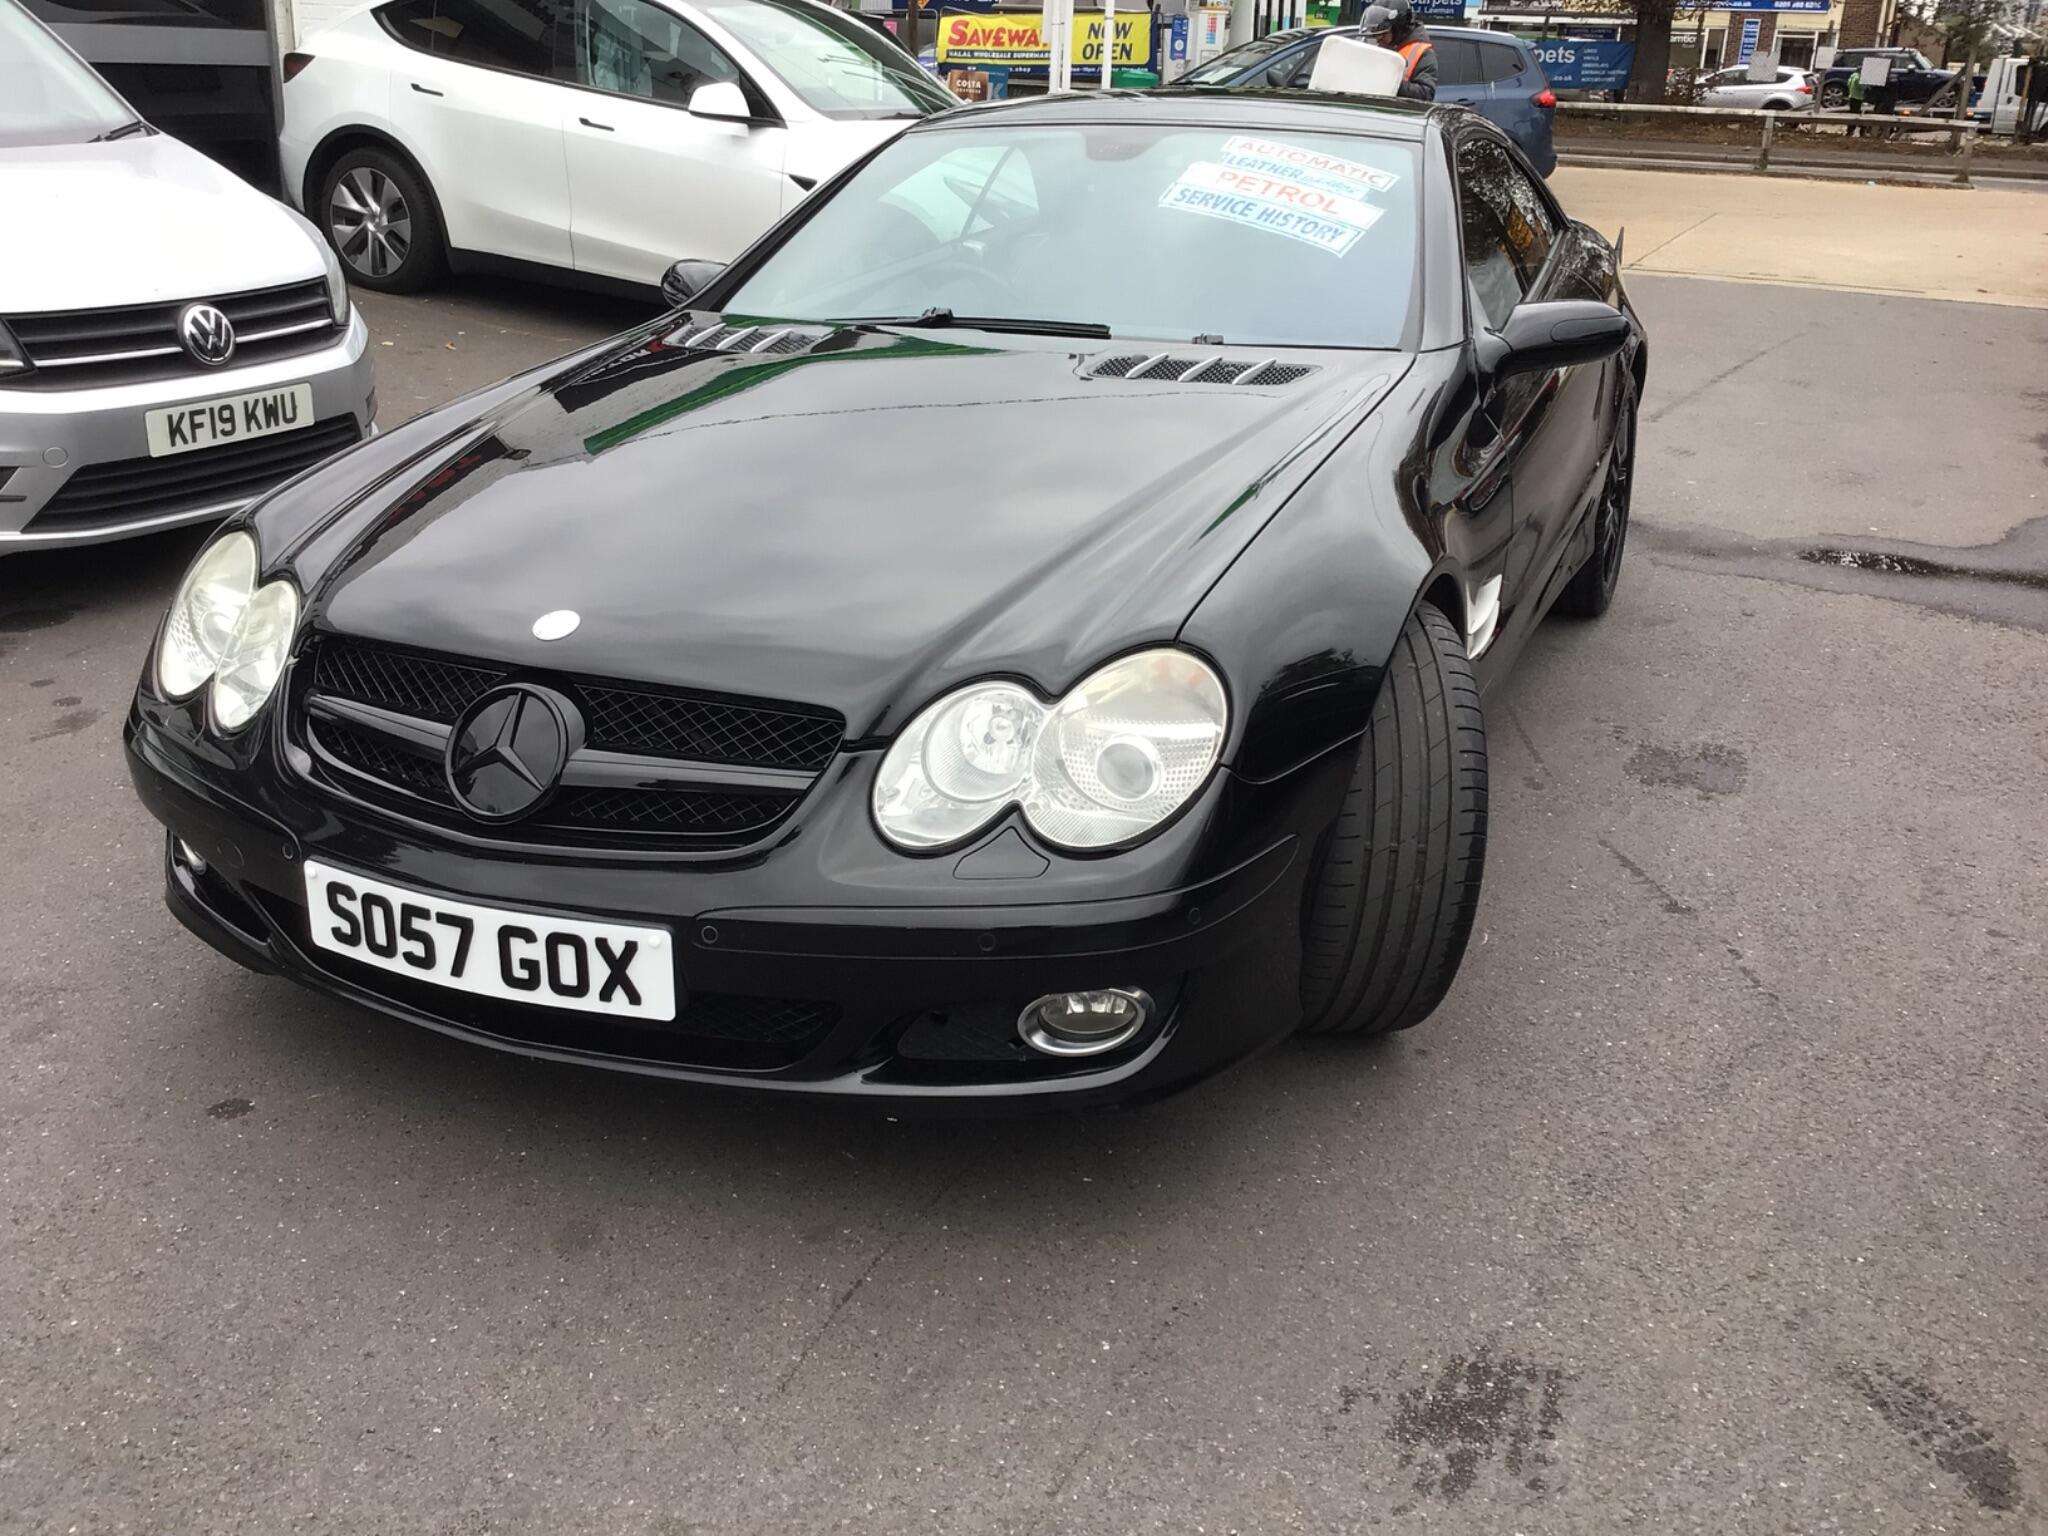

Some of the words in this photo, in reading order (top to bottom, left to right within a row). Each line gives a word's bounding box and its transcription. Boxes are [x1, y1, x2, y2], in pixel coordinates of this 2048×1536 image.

[948, 19, 1049, 47] SAV£WA
[956, 79, 981, 89] COSTA
[1227, 155, 1303, 181] LEATHER
[1236, 140, 1386, 186] AUTOMATIC
[1217, 171, 1339, 215] PETROL
[1174, 188, 1254, 218] SERVICE
[1257, 204, 1346, 244] HISTORY
[167, 404, 236, 448] KF19
[244, 392, 298, 434] KWU
[496, 924, 642, 1006] GOX
